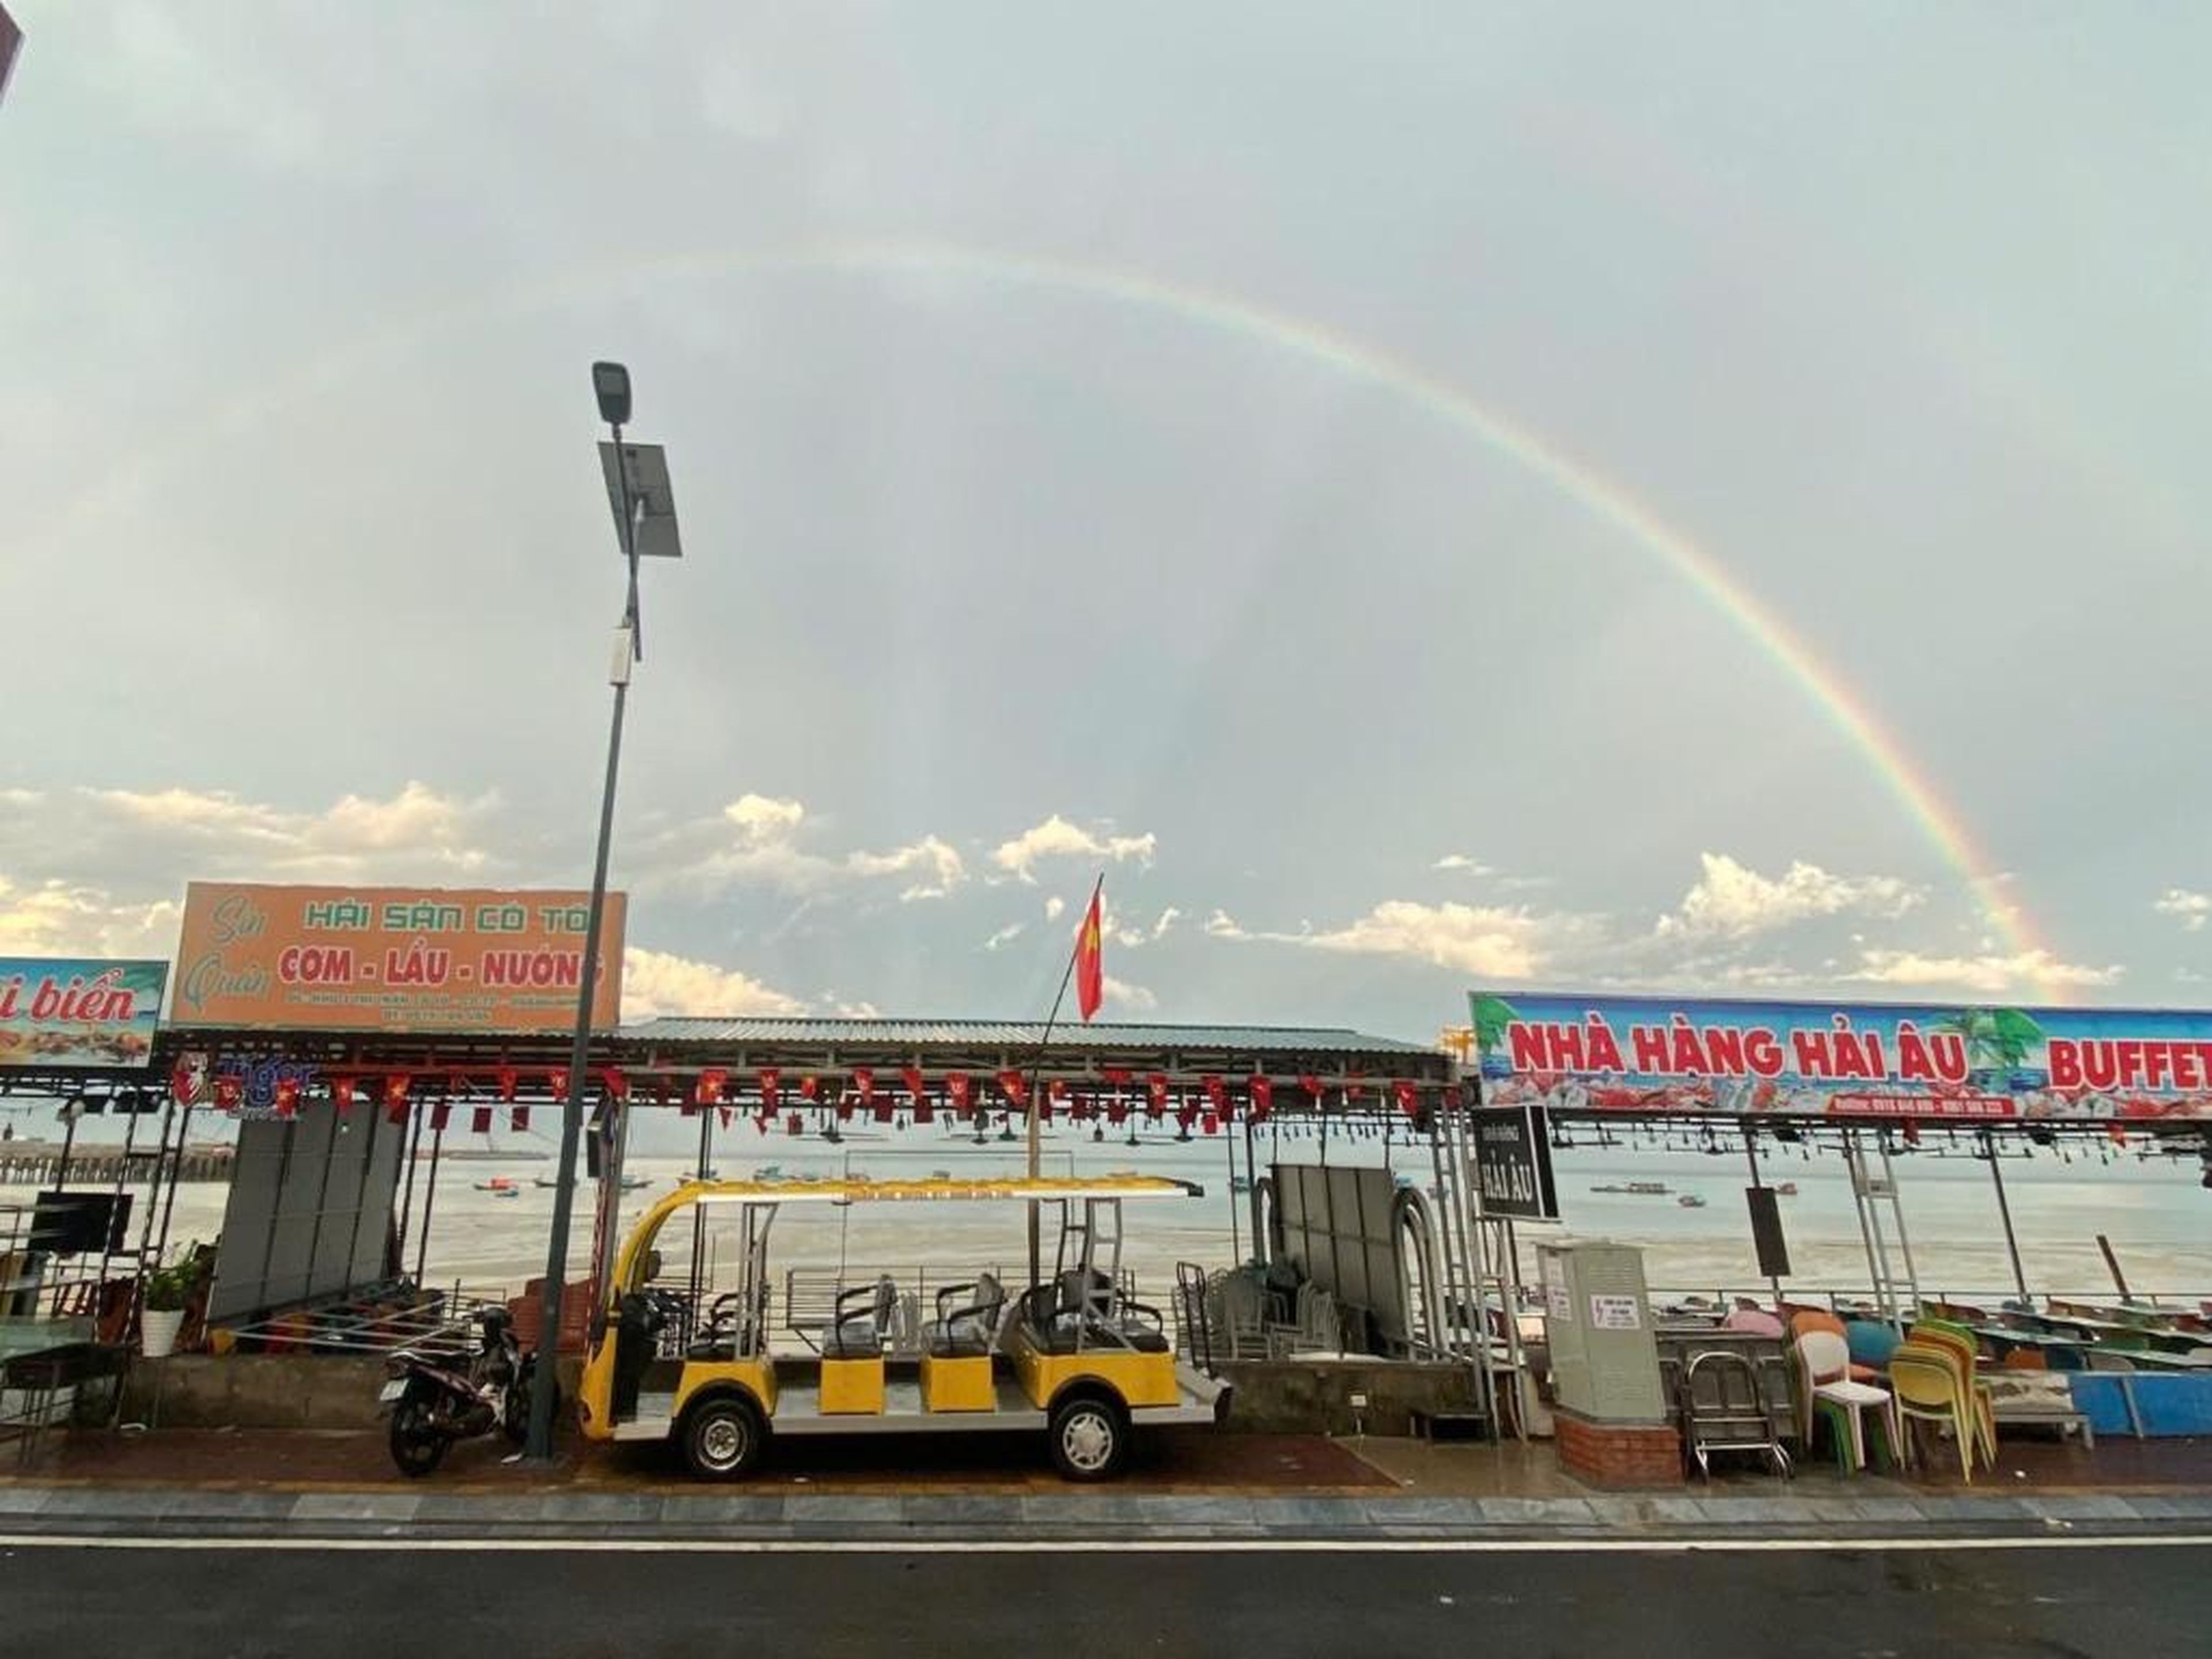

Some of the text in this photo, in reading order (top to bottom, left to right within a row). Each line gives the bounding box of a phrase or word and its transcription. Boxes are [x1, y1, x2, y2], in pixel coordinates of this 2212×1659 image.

[304, 897, 372, 932] HẢI
[381, 899, 464, 932] SẢN
[278, 945, 353, 984] CƠM
[384, 935, 450, 986] LẨU
[482, 944, 604, 987] NƯỚN
[29, 968, 137, 1023] biển
[1507, 1010, 1969, 1083] NHÀ HÀNG HẢI ÂU
